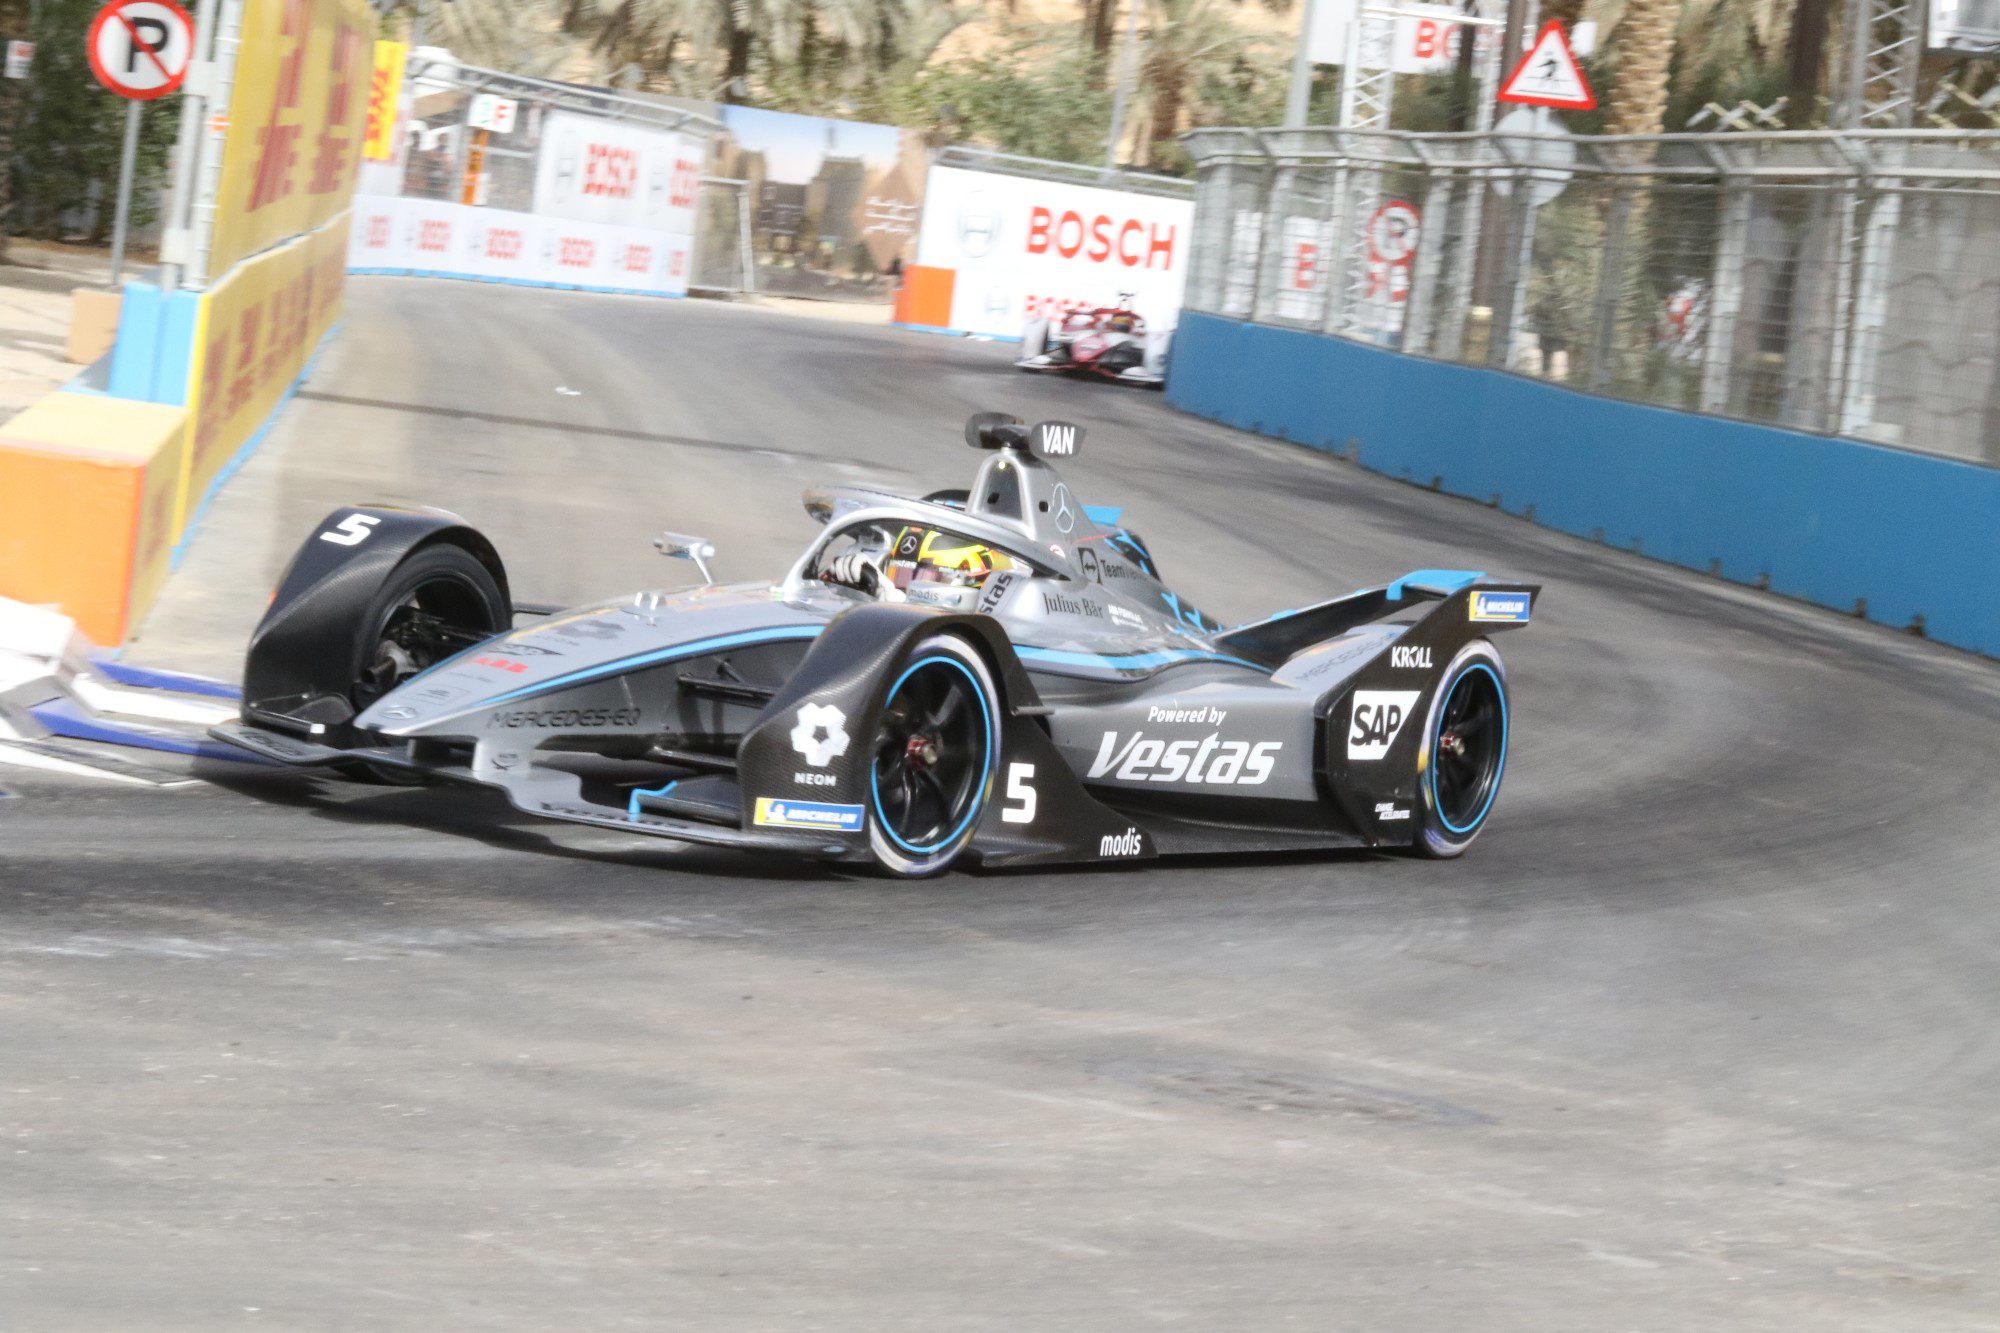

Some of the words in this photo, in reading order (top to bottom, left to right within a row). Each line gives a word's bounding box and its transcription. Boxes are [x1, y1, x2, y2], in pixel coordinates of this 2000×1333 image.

[1027, 206, 1176, 270] BOSCH
[1042, 424, 1075, 454] VAN
[319, 513, 382, 546] 5
[1043, 592, 1081, 616] Julius
[1081, 598, 1104, 619] Bär
[1391, 645, 1433, 668] KROLL
[1147, 706, 1206, 723] Powered
[1208, 708, 1227, 726] by
[1350, 703, 1401, 747] SAP
[1086, 731, 1284, 785] Vestas
[1001, 762, 1037, 824] 5
[1099, 827, 1142, 857] modis
